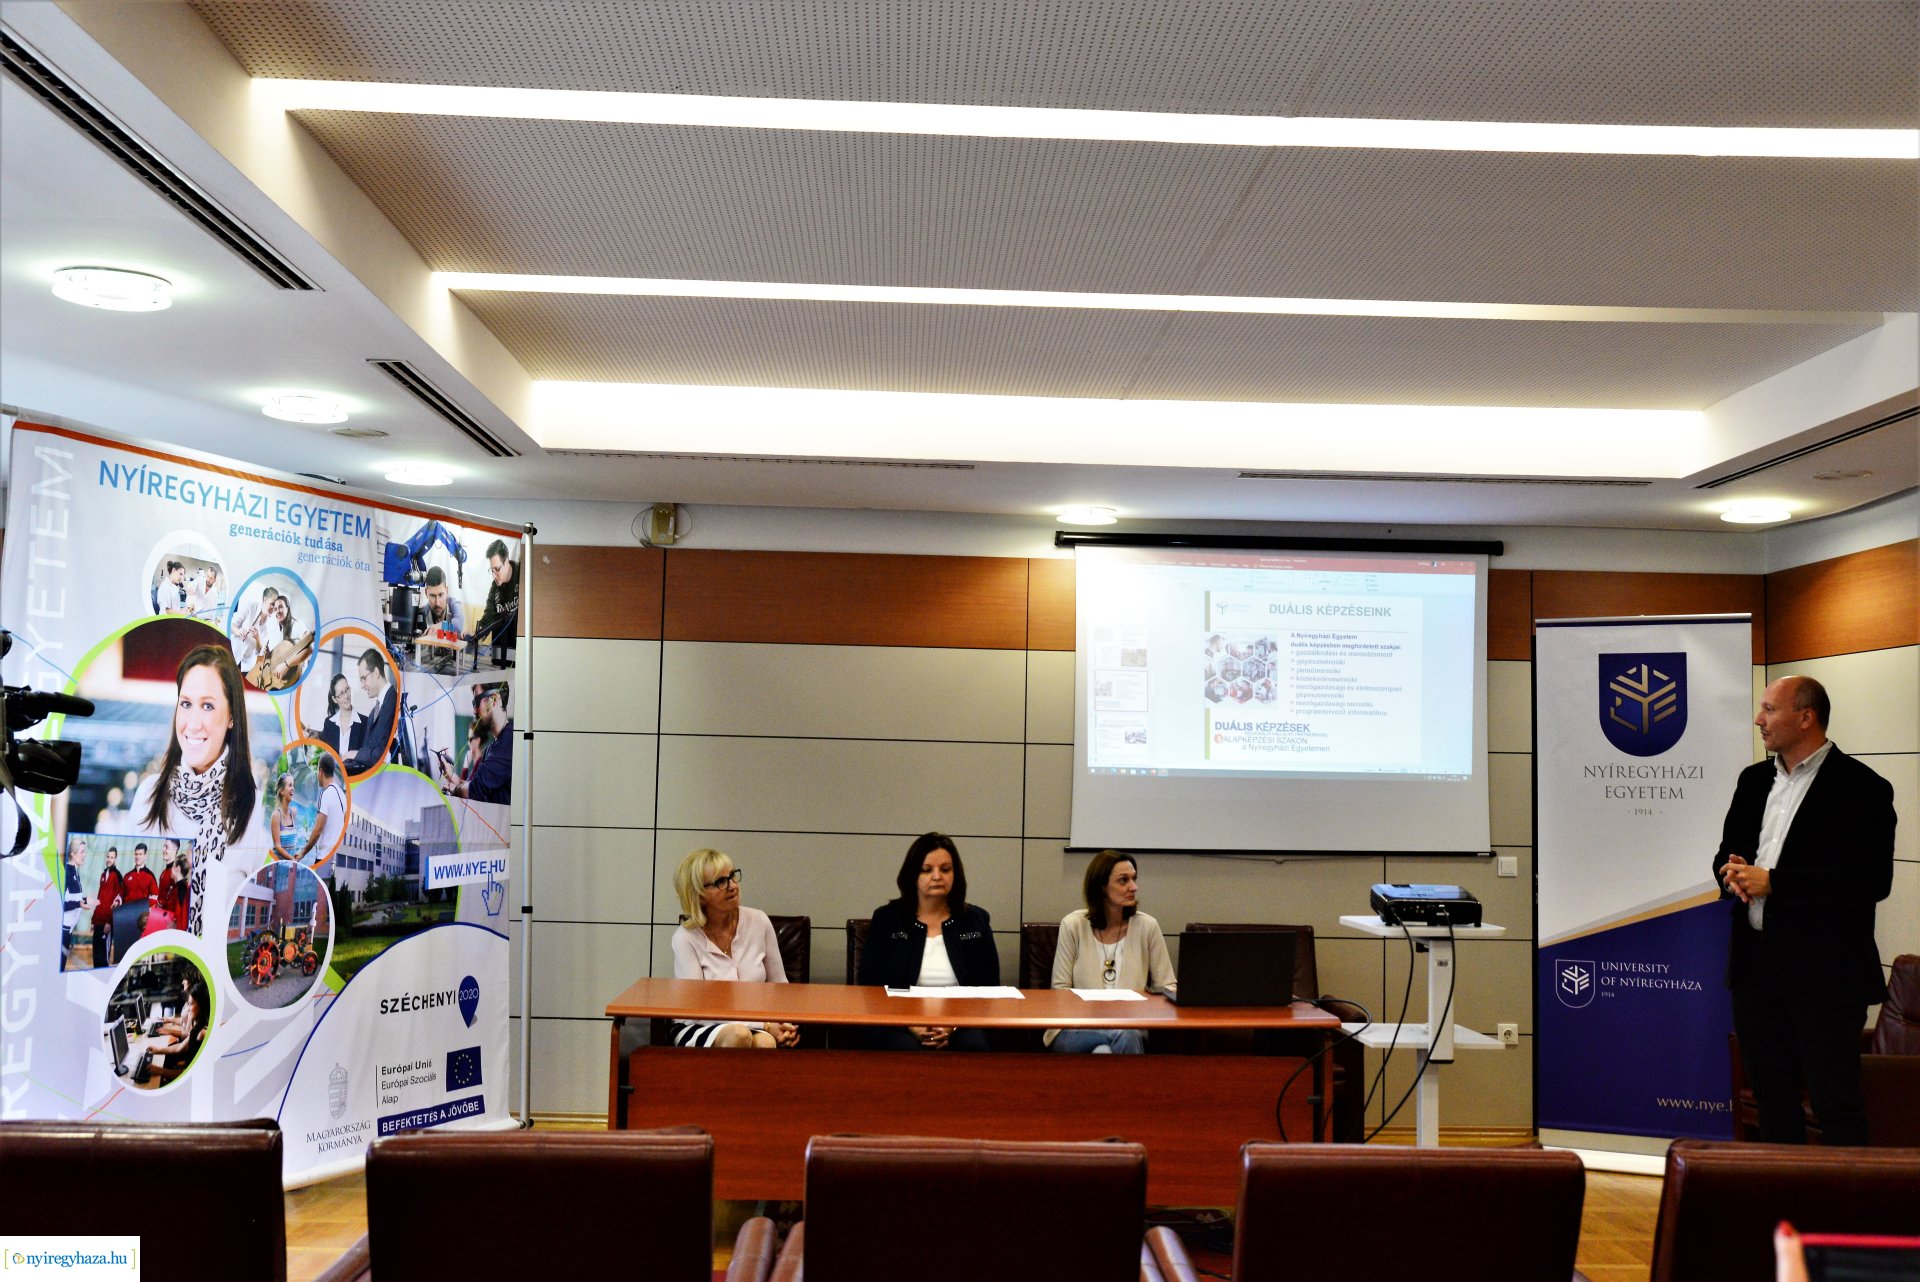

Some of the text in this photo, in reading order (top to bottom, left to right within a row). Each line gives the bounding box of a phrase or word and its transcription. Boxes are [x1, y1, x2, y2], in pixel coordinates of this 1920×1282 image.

[99, 460, 371, 539] NYÍREGYHÁZI EGYETEM
[229, 523, 343, 553] generációk tudása
[297, 551, 371, 572] generációk óta
[23, 445, 74, 738] GYETEM
[1269, 602, 1313, 615] DUÁLIS
[1316, 602, 1392, 617] KÉPZÉSEINK
[1214, 720, 1311, 733] DUÁLIS KÉPZÉSEK
[1584, 763, 1704, 779] NYÍREGYHÁZI
[1605, 785, 1684, 800] EGYETEM
[1634, 808, 1652, 816] 1914
[433, 859, 506, 880] WWW.NYE.HU
[1601, 961, 1670, 974] UNIVERSITY
[1600, 976, 1703, 991] OF NYÍREGYHÁZA
[380, 987, 479, 1015] SZÉCHENYI 2020
[381, 1061, 413, 1076] Európai
[381, 1095, 399, 1106] Alap
[382, 1110, 438, 1133] BEFEKTETÉS
[440, 1111, 446, 1120] A
[306, 1119, 371, 1143] MAGYARORSZÁG
[318, 1135, 363, 1153] KORMÁNYA
